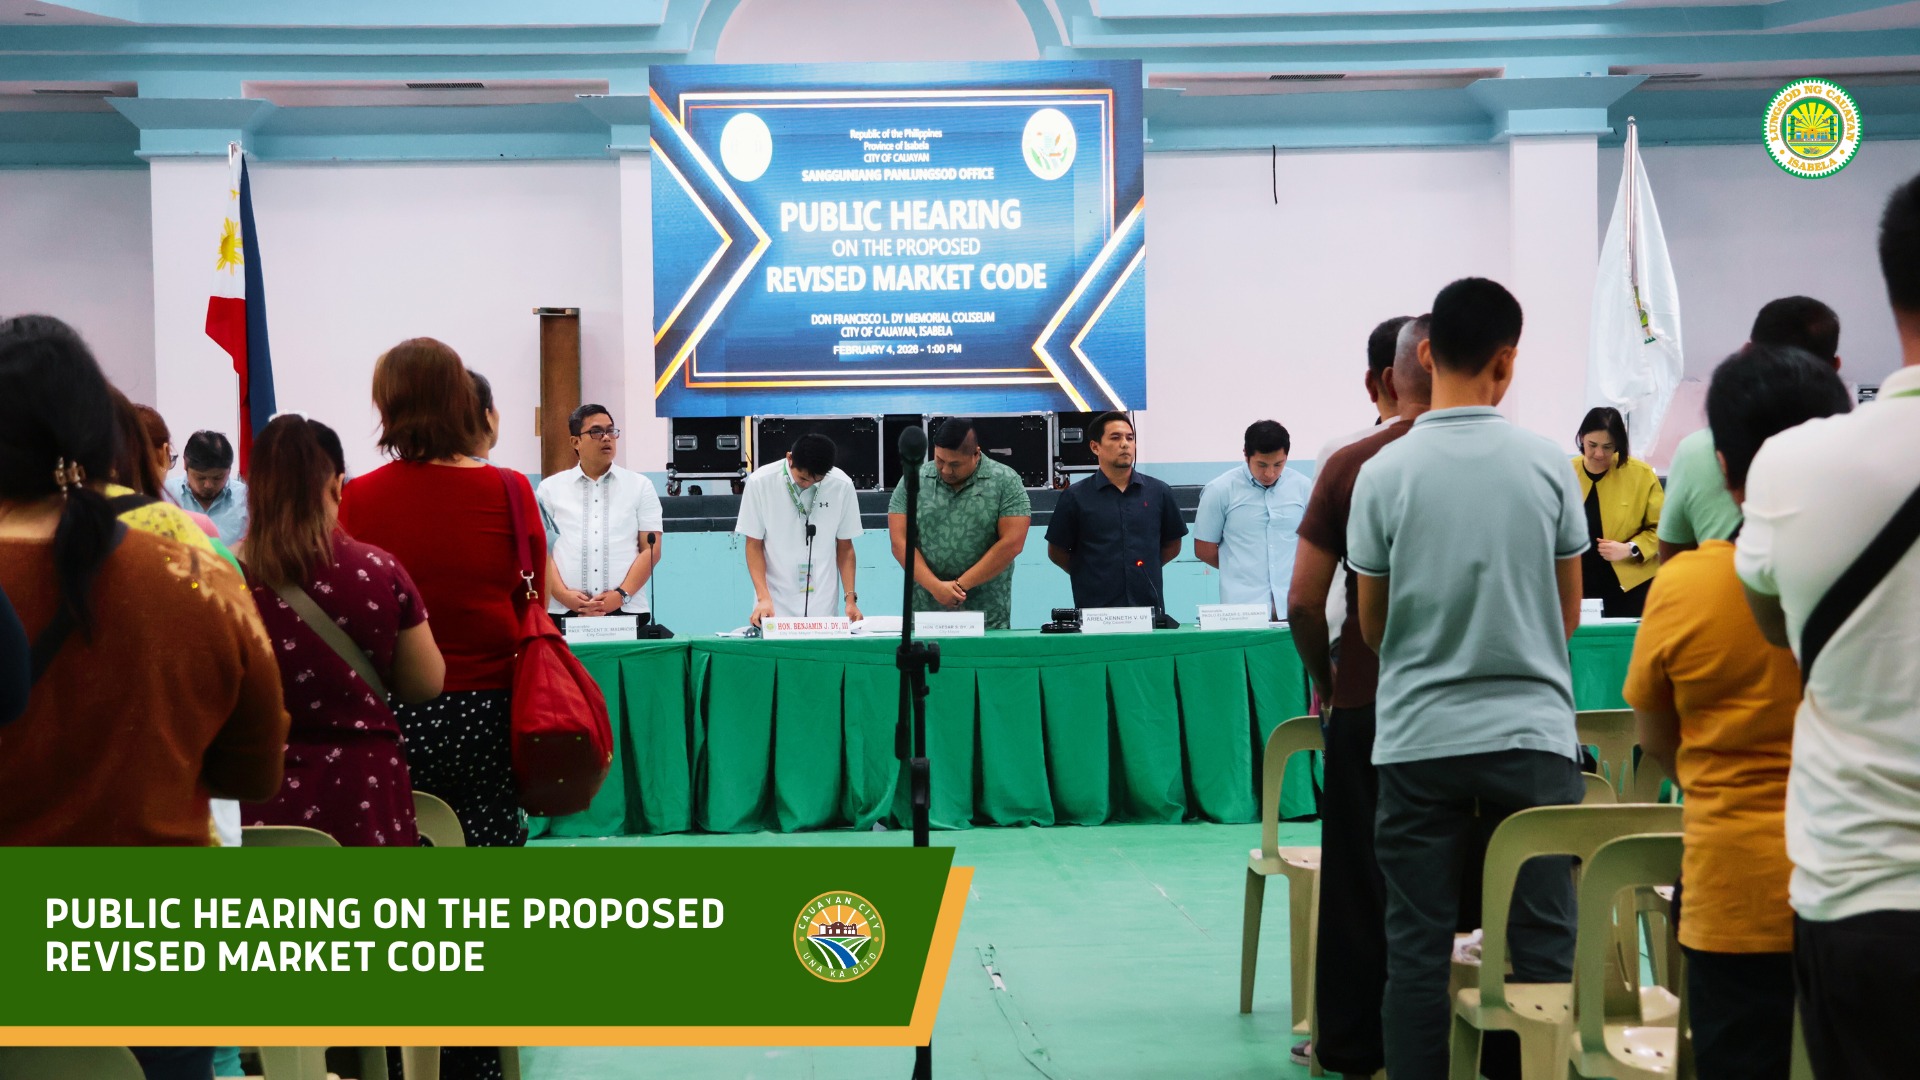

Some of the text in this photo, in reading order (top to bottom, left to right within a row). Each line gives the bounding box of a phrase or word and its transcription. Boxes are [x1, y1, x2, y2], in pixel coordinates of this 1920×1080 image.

[850, 128, 943, 141] Republic of the Philippines
[863, 141, 930, 151] Province of Isabela
[863, 153, 930, 163] CITY OF CAUAYAN
[801, 167, 995, 182] SANGGUNIANG PANLUNGSOD OFFICE
[780, 198, 1022, 233] PUBLIC HEARING
[832, 237, 981, 257] ON THE PROPOSED
[766, 262, 1047, 293] REVISED MARKET CODE
[811, 314, 832, 325] DON
[833, 313, 881, 325] FRANCISCO
[891, 313, 904, 324] DY
[905, 312, 951, 324] MEMORIAL
[951, 311, 995, 323] COLISEUM
[840, 325, 953, 338] CITY OF CAUAYAN, ISABELA
[833, 345, 886, 355] FEBRUARY
[886, 345, 895, 355] 4,
[896, 344, 919, 354] 2026
[926, 344, 946, 354] 1:00
[946, 343, 962, 353] PM
[777, 622, 792, 630] HON.
[793, 622, 823, 630] BENJAMIN
